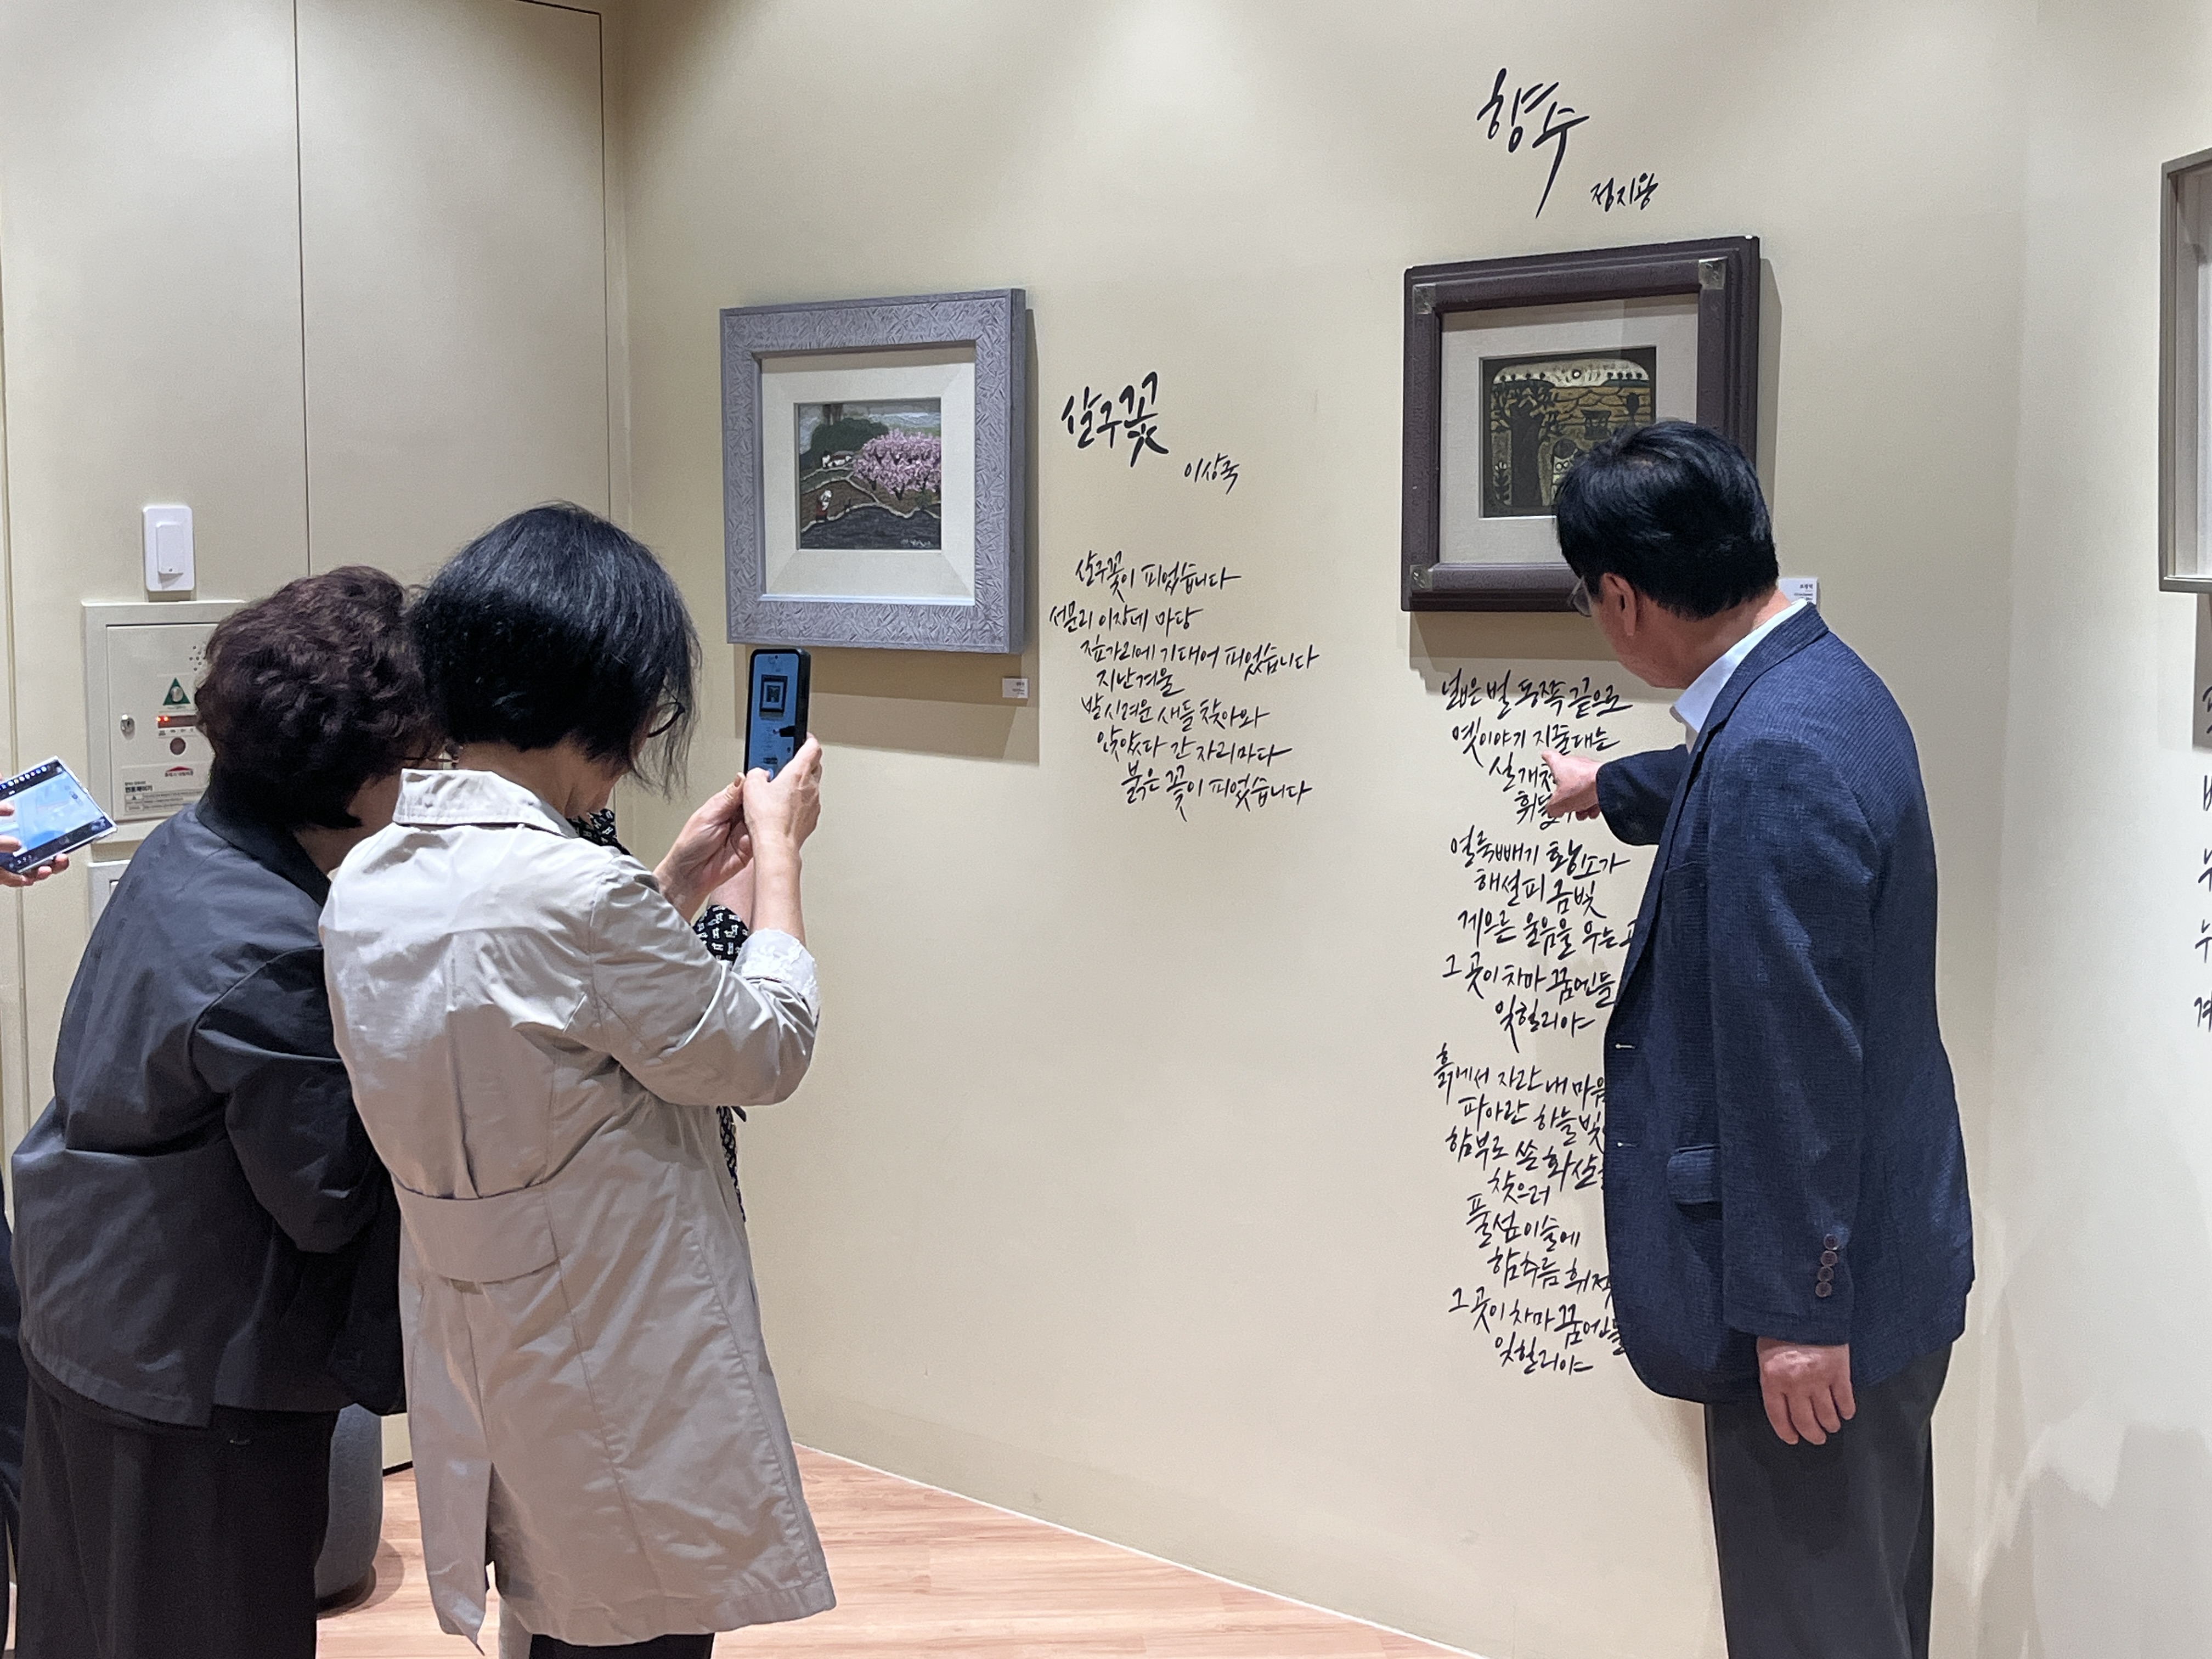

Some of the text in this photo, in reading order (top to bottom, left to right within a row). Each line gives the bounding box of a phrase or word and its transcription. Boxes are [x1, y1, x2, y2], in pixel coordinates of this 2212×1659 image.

[1476, 67, 1590, 218] 향수
[1061, 371, 1170, 467] 살구꽃
[1184, 453, 1240, 495] 이상국
[1075, 550, 1242, 602] 살구꽃이 피었습니다
[1049, 601, 1204, 637] 서문리 이장네 마당
[1160, 645, 1220, 669] 기대어
[1224, 642, 1320, 681] 피었습니다
[1158, 699, 1194, 731] 새들
[1200, 698, 1271, 729] 찾아와
[1442, 667, 1633, 720] 넓은 벌 동쪽 끝으로
[1097, 725, 1293, 766] 앉았다 간 자리마다
[1121, 760, 1313, 822] 붉은 꽃이 피었습니다
[1451, 825, 1630, 880] 얼룩빼기 황소가
[1475, 868, 1607, 918] 해설피 금빛
[1458, 908, 1516, 947] 게으른
[1523, 912, 1576, 960] 울음을
[1582, 921, 1618, 954] 우는
[1502, 964, 1547, 992] 차마
[1546, 967, 1616, 1008] 꿈엔들
[1434, 1042, 1489, 1105] 흙에서
[1498, 1065, 1543, 1091] 자란
[1545, 1076, 1568, 1096] 내
[1458, 1093, 1530, 1132] 파아란
[1445, 1125, 1509, 1171] 함부로
[1515, 1139, 1539, 1171] 쏜
[1487, 1167, 1551, 1206] 찾으러
[1524, 1215, 1581, 1252] 이슬에
[1509, 1299, 1556, 1332] 차마
